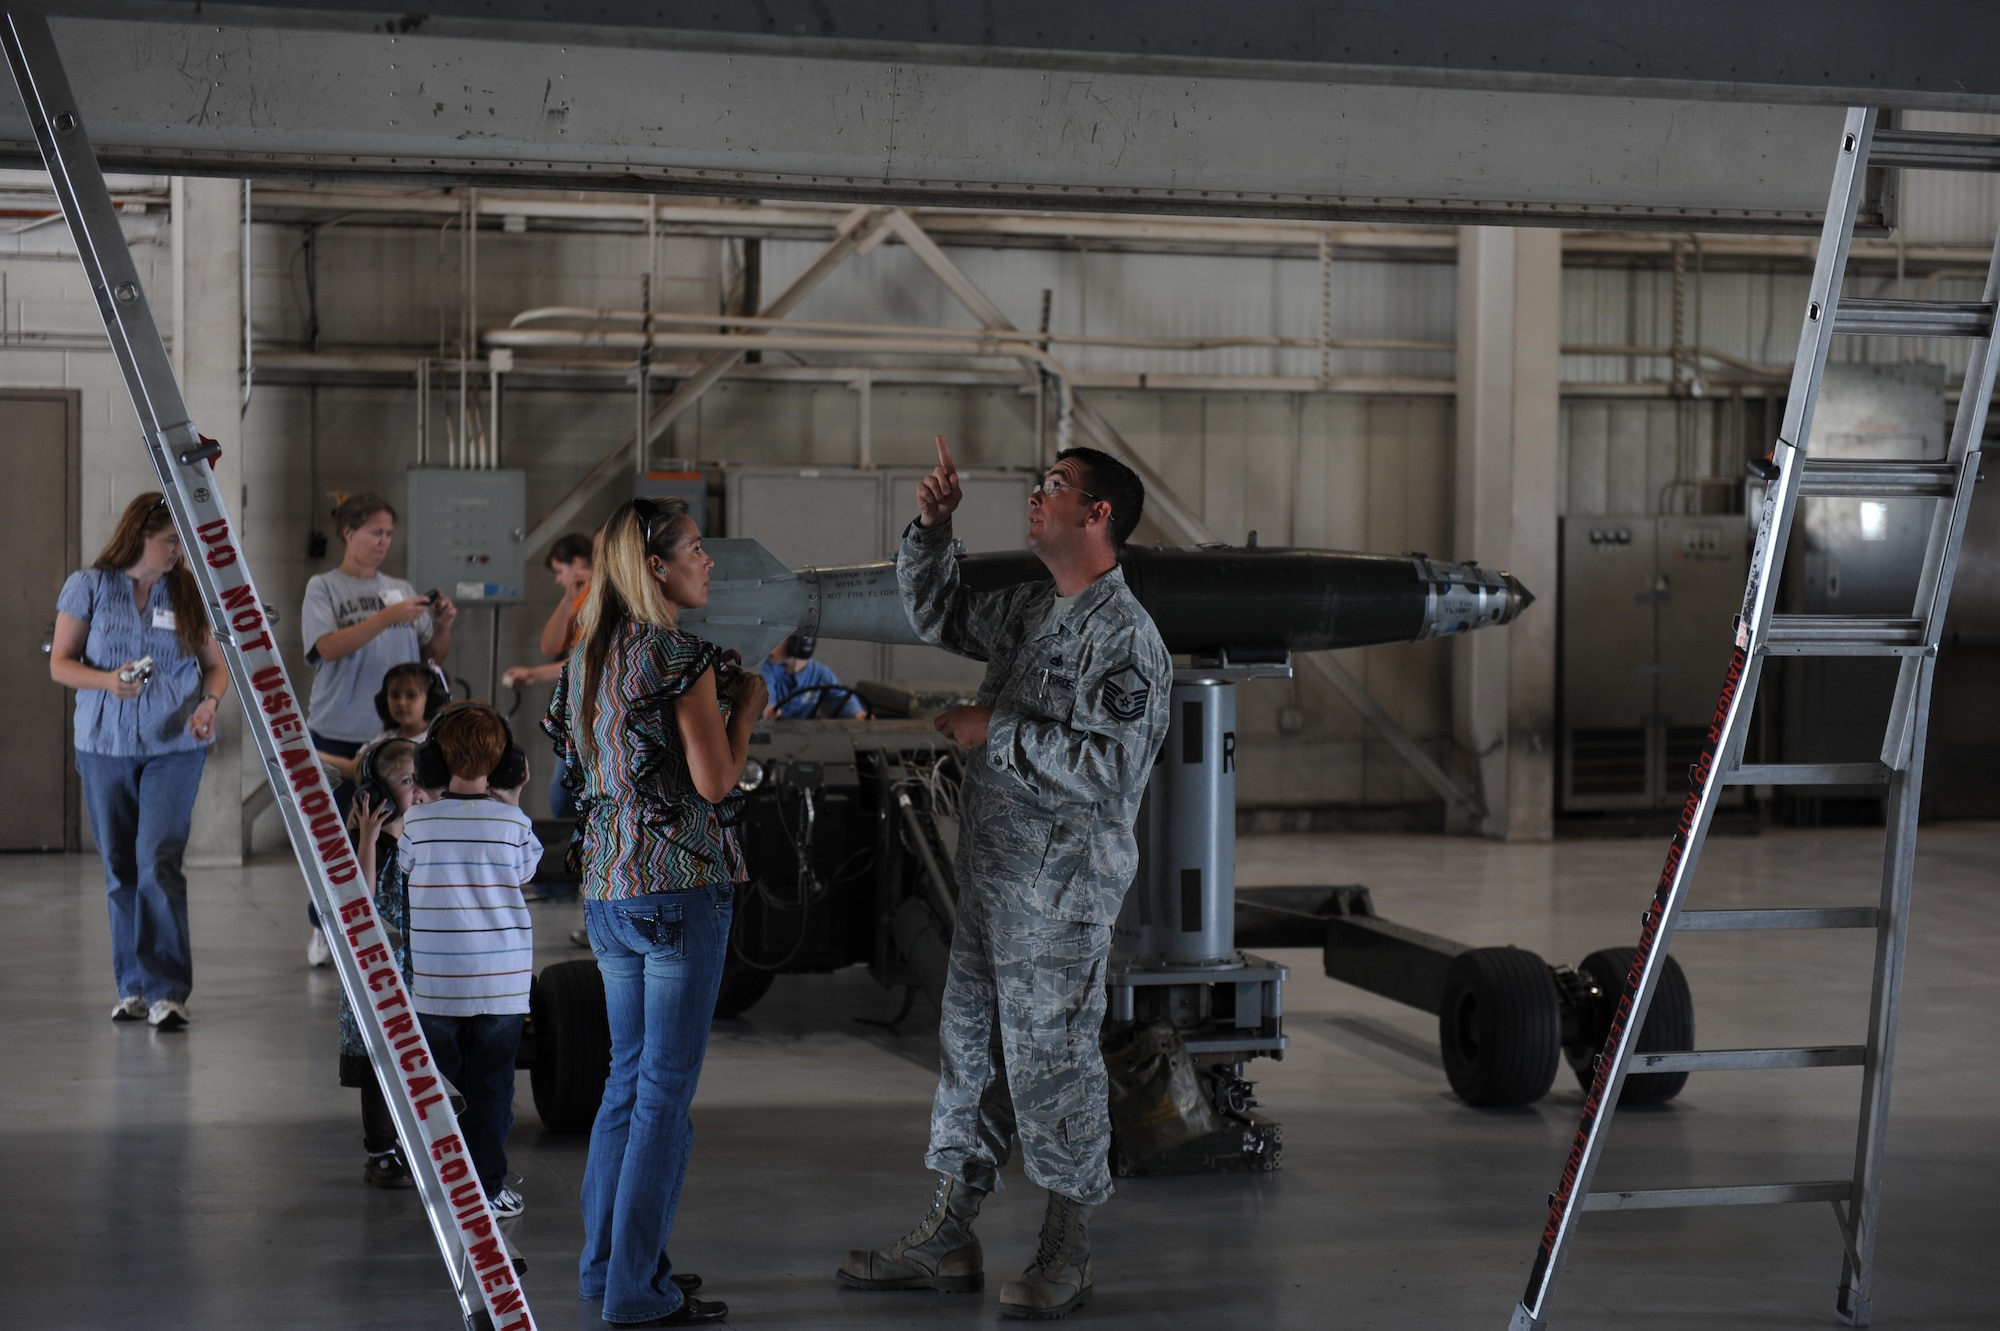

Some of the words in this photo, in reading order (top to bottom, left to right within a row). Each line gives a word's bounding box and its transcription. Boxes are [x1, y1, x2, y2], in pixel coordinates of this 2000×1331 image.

[359, 595, 387, 612] DHA
[868, 589, 899, 598] FLIGHT
[1049, 673, 1077, 691] FORCE
[1706, 649, 1746, 742] DANGER
[1694, 749, 1714, 786] DO
[1676, 790, 1702, 838] NOT
[1657, 841, 1684, 893] USE
[197, 518, 236, 569] DO
[220, 584, 273, 652] NOT
[251, 665, 302, 742] USE
[280, 749, 357, 885] AROUND
[340, 896, 443, 1121] ELECTRICAL
[431, 1134, 532, 1331] EQUIPMENT
[1627, 897, 1663, 989] AROUND
[1582, 992, 1633, 1119] ELECTRICAL
[1539, 1128, 1588, 1256] EQUIPMENT
